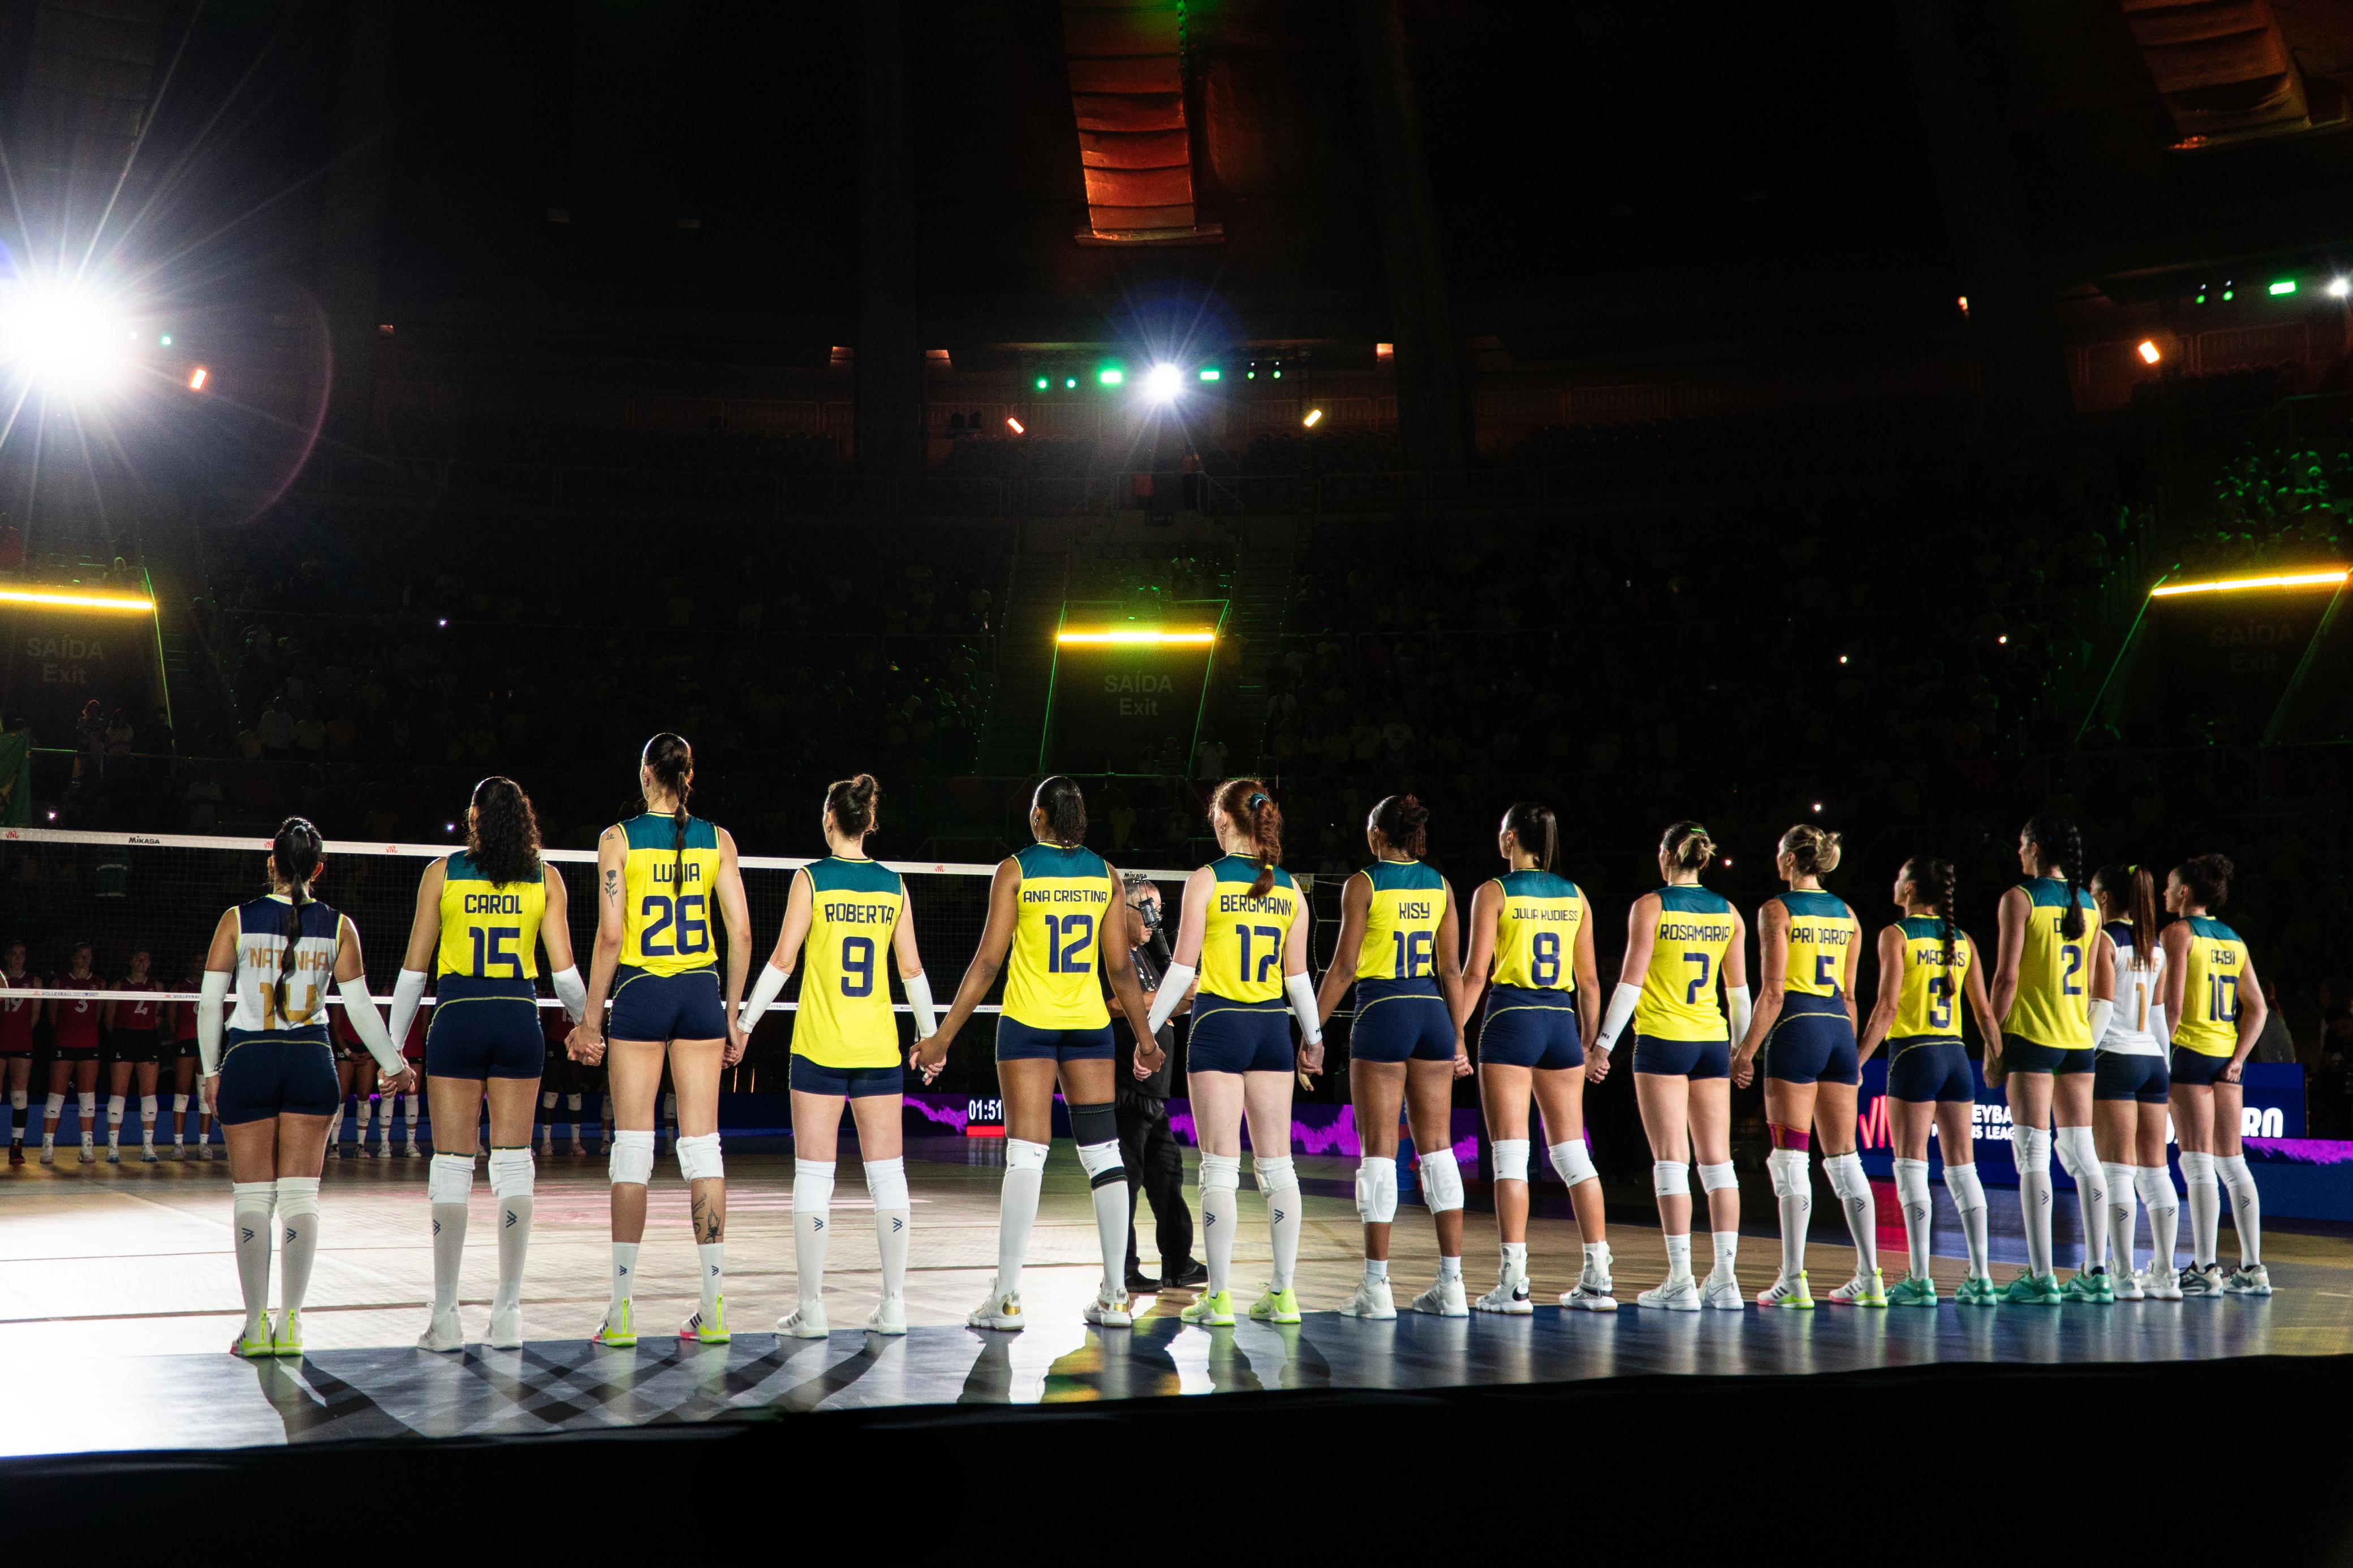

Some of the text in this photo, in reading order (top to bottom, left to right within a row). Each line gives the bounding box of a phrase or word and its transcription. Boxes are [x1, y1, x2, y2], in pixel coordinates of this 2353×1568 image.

[27, 633, 104, 660] SAÍDA
[42, 663, 85, 683] Exit
[1105, 670, 1174, 692] SAÍDA
[1120, 698, 1158, 715] Exit
[654, 863, 700, 882] LUIA
[464, 895, 523, 914] CAROL
[1023, 890, 1107, 904] ANA CRISTINA
[1220, 895, 1292, 917] BERGMANN
[825, 903, 895, 926] ROBERTA
[1399, 902, 1430, 919] KISY
[1512, 908, 1578, 921] JULIA KUDIESS
[641, 895, 709, 956] 26
[1660, 924, 1730, 941] ROSAMARIA
[1791, 928, 1814, 943] PRI
[469, 927, 524, 978] 15
[1045, 914, 1093, 973] 12
[1236, 924, 1282, 982] 17
[1394, 931, 1433, 978] 16
[249, 948, 328, 971] NATNHA
[841, 936, 874, 997] 9
[1532, 932, 1561, 986] 8
[1917, 949, 1965, 967] MACIS
[1683, 952, 1709, 1004] 7
[1815, 955, 1840, 996] 5
[2062, 945, 2082, 995] 2
[1929, 977, 1952, 1028] 3
[2136, 983, 2146, 1031] 1
[2208, 973, 2239, 1022] 10
[969, 1100, 1002, 1120] 01:51
